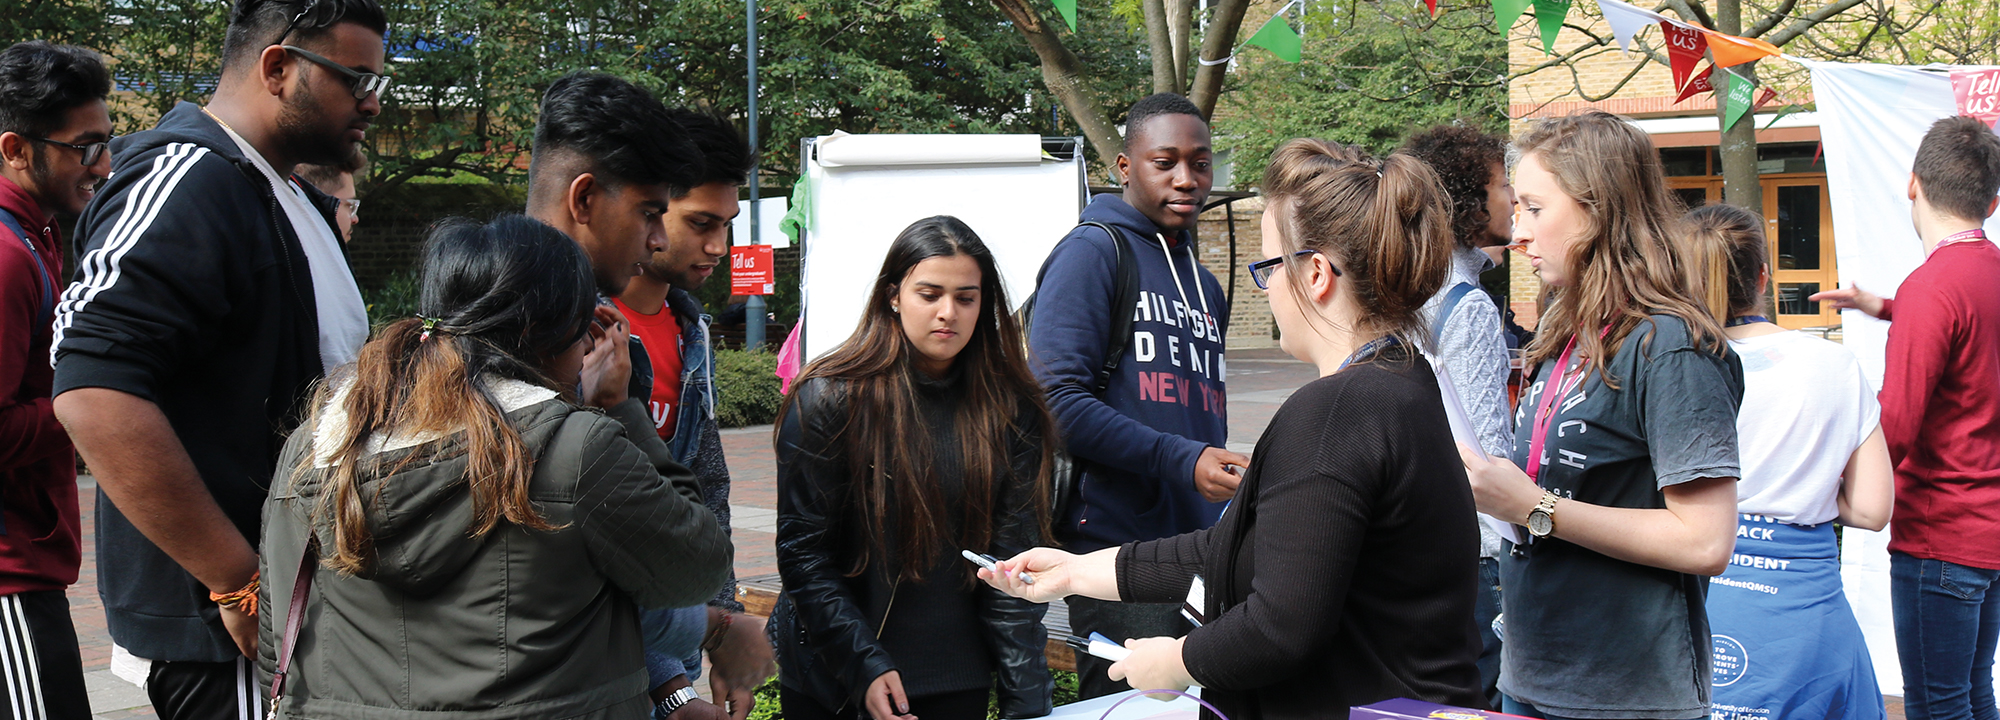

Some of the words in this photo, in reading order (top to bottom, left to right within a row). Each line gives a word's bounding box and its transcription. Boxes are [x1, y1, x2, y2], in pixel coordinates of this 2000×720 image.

[1672, 34, 1697, 50] us
[1738, 81, 1752, 95] We
[1966, 71, 2000, 96] Tell
[1966, 96, 1996, 114] us
[732, 253, 744, 269] Tell
[745, 257, 755, 269] us
[1133, 290, 1222, 344] HILFIGE
[1139, 371, 1190, 407] NEW
[1729, 554, 1790, 571] IDENT
